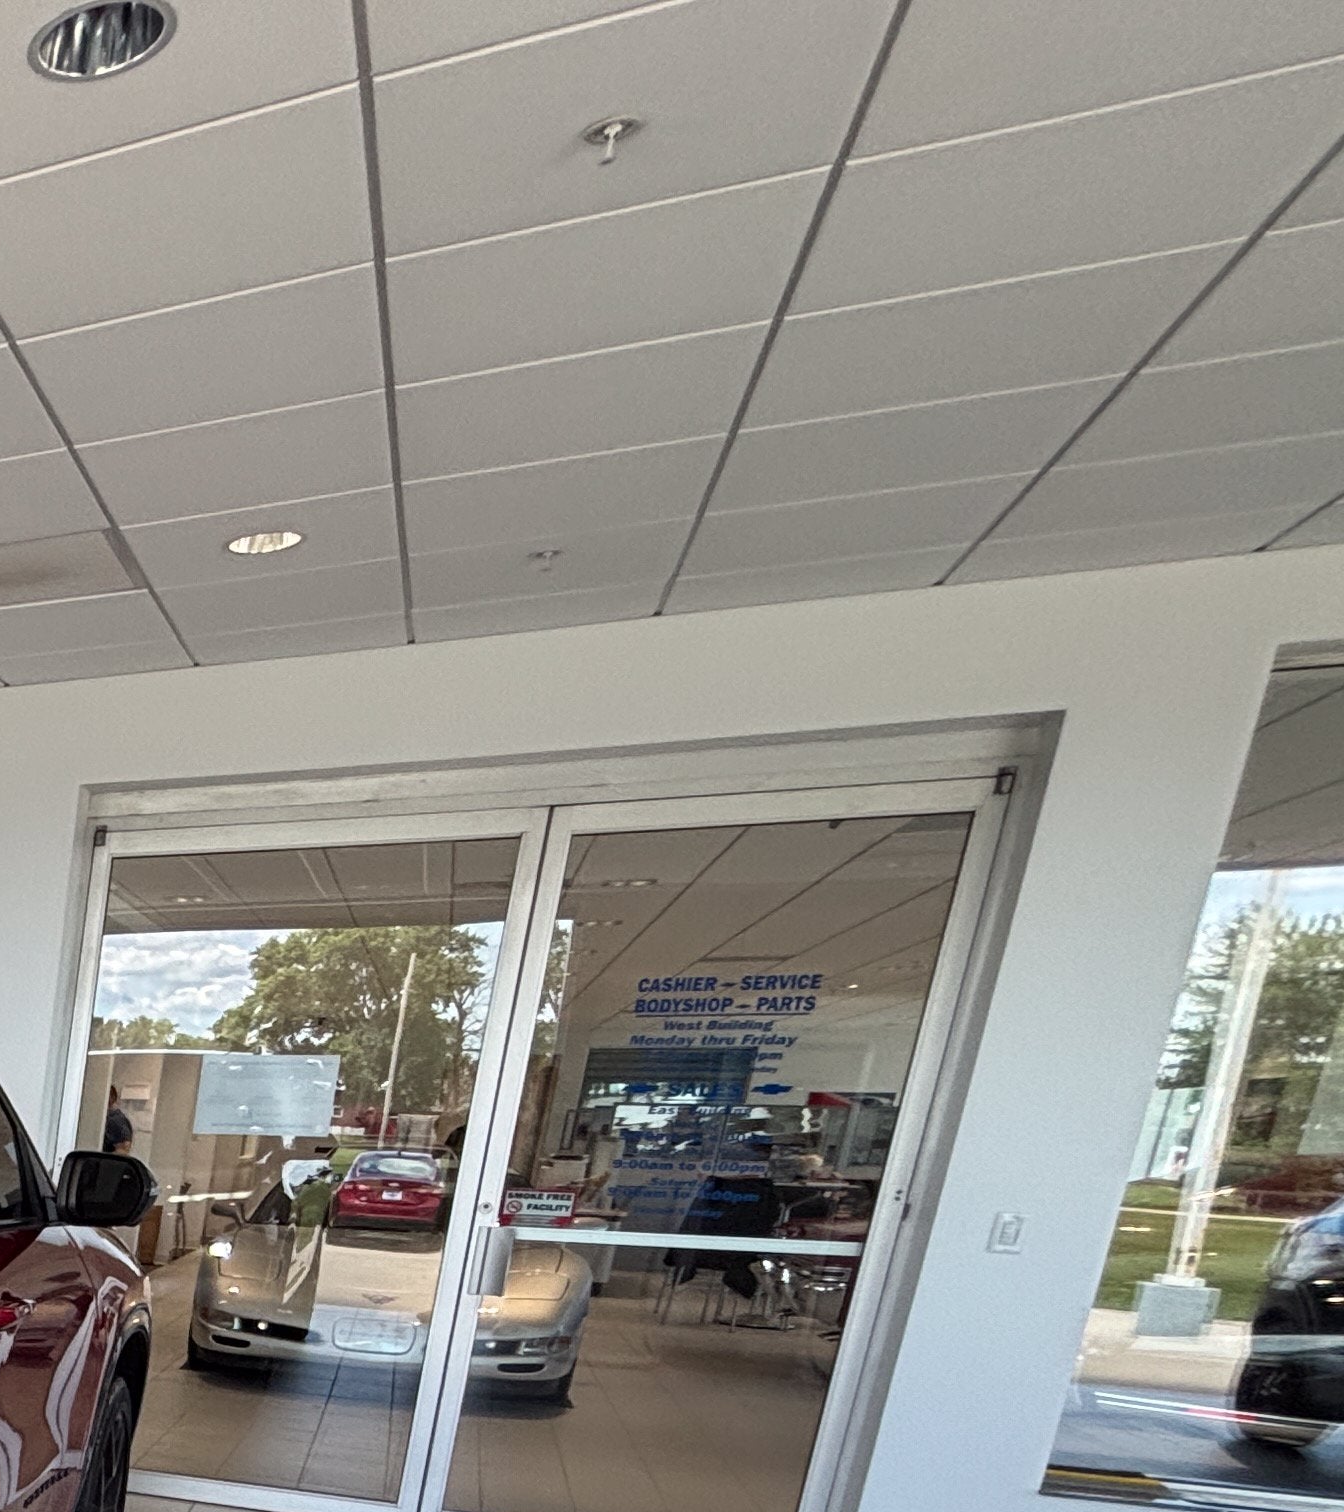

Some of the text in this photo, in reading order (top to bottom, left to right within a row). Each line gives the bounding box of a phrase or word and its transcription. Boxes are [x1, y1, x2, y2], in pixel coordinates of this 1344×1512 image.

[638, 976, 717, 992] CASHIER
[740, 974, 824, 991] SERVICE
[633, 997, 734, 1013] BODYSHOP
[755, 995, 817, 1012] PARTS
[663, 1020, 775, 1032] West Building
[629, 1034, 798, 1047] Monday thru Friday
[679, 1161, 697, 1171] to
[507, 1192, 573, 1201] SMOKE FREE
[526, 1203, 571, 1212] FACILITY
